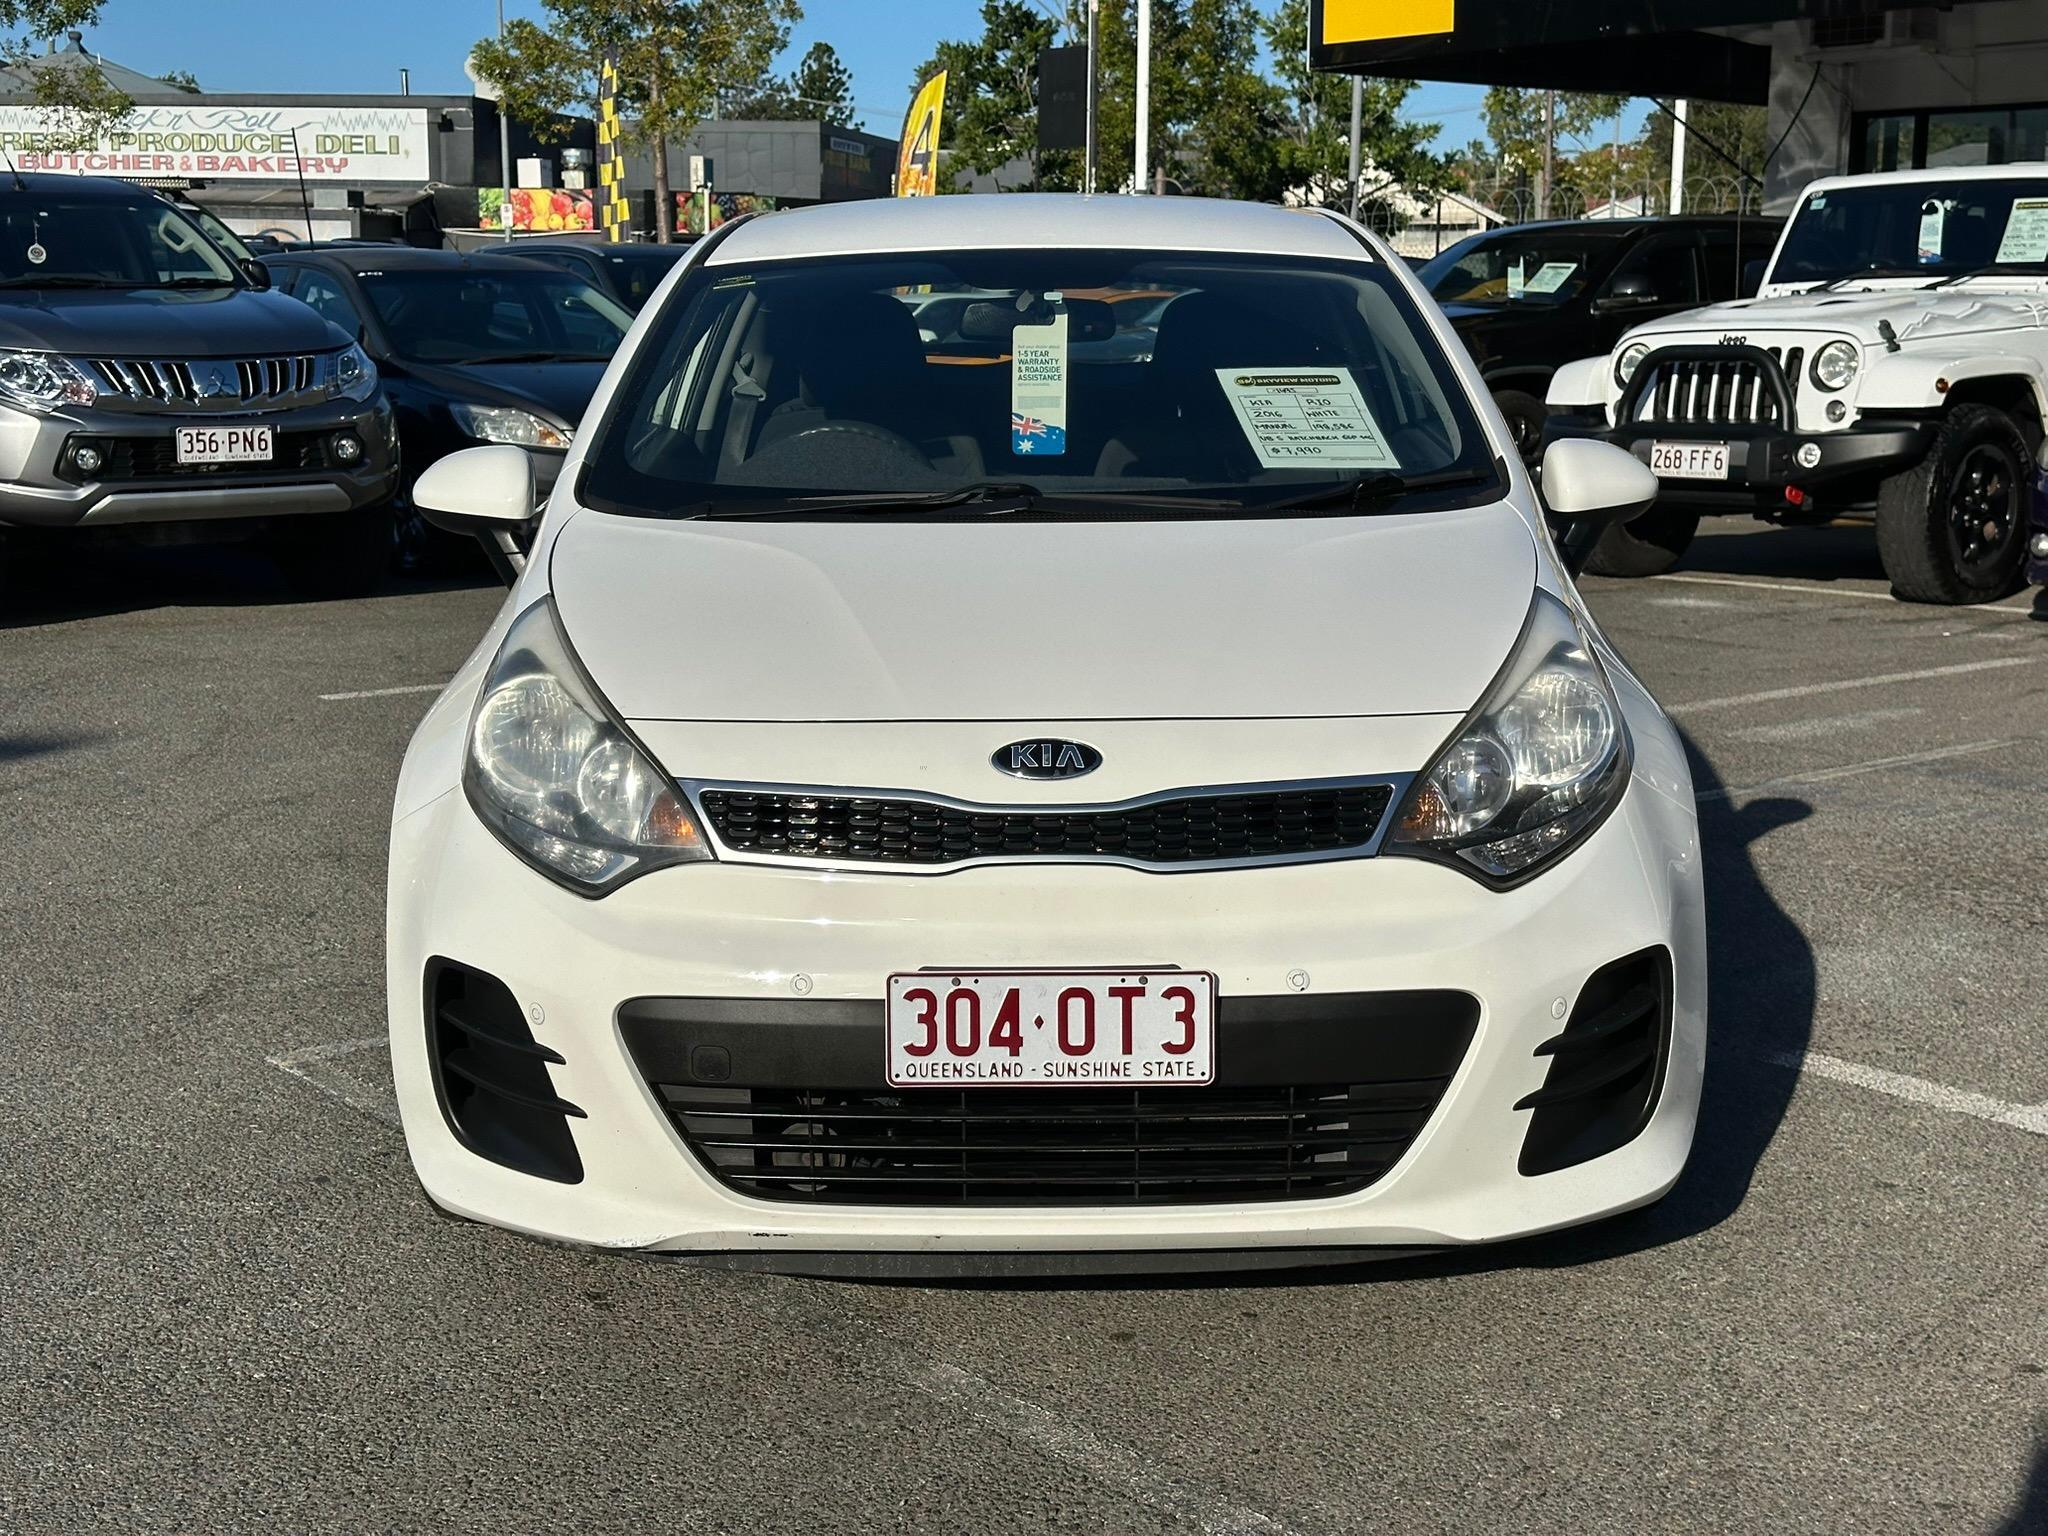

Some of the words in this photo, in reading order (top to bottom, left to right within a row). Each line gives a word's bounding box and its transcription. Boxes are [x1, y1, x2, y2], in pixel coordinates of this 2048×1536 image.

[196, 108, 288, 132] Roll
[18, 153, 175, 171] BUTCHER
[180, 155, 192, 171] &
[197, 155, 349, 173] BAKERY
[1718, 333, 1747, 347] Jeep
[1030, 350, 1049, 358] YEAR
[1306, 398, 1331, 406] RIO
[1253, 410, 1283, 418] 2016
[1305, 410, 1341, 418] WHITE
[1010, 743, 1085, 769] KIA
[905, 1061, 1024, 1079] QUEENSLAND
[1043, 1061, 1132, 1078] SUNSHINE
[1142, 1060, 1196, 1078] STATE
